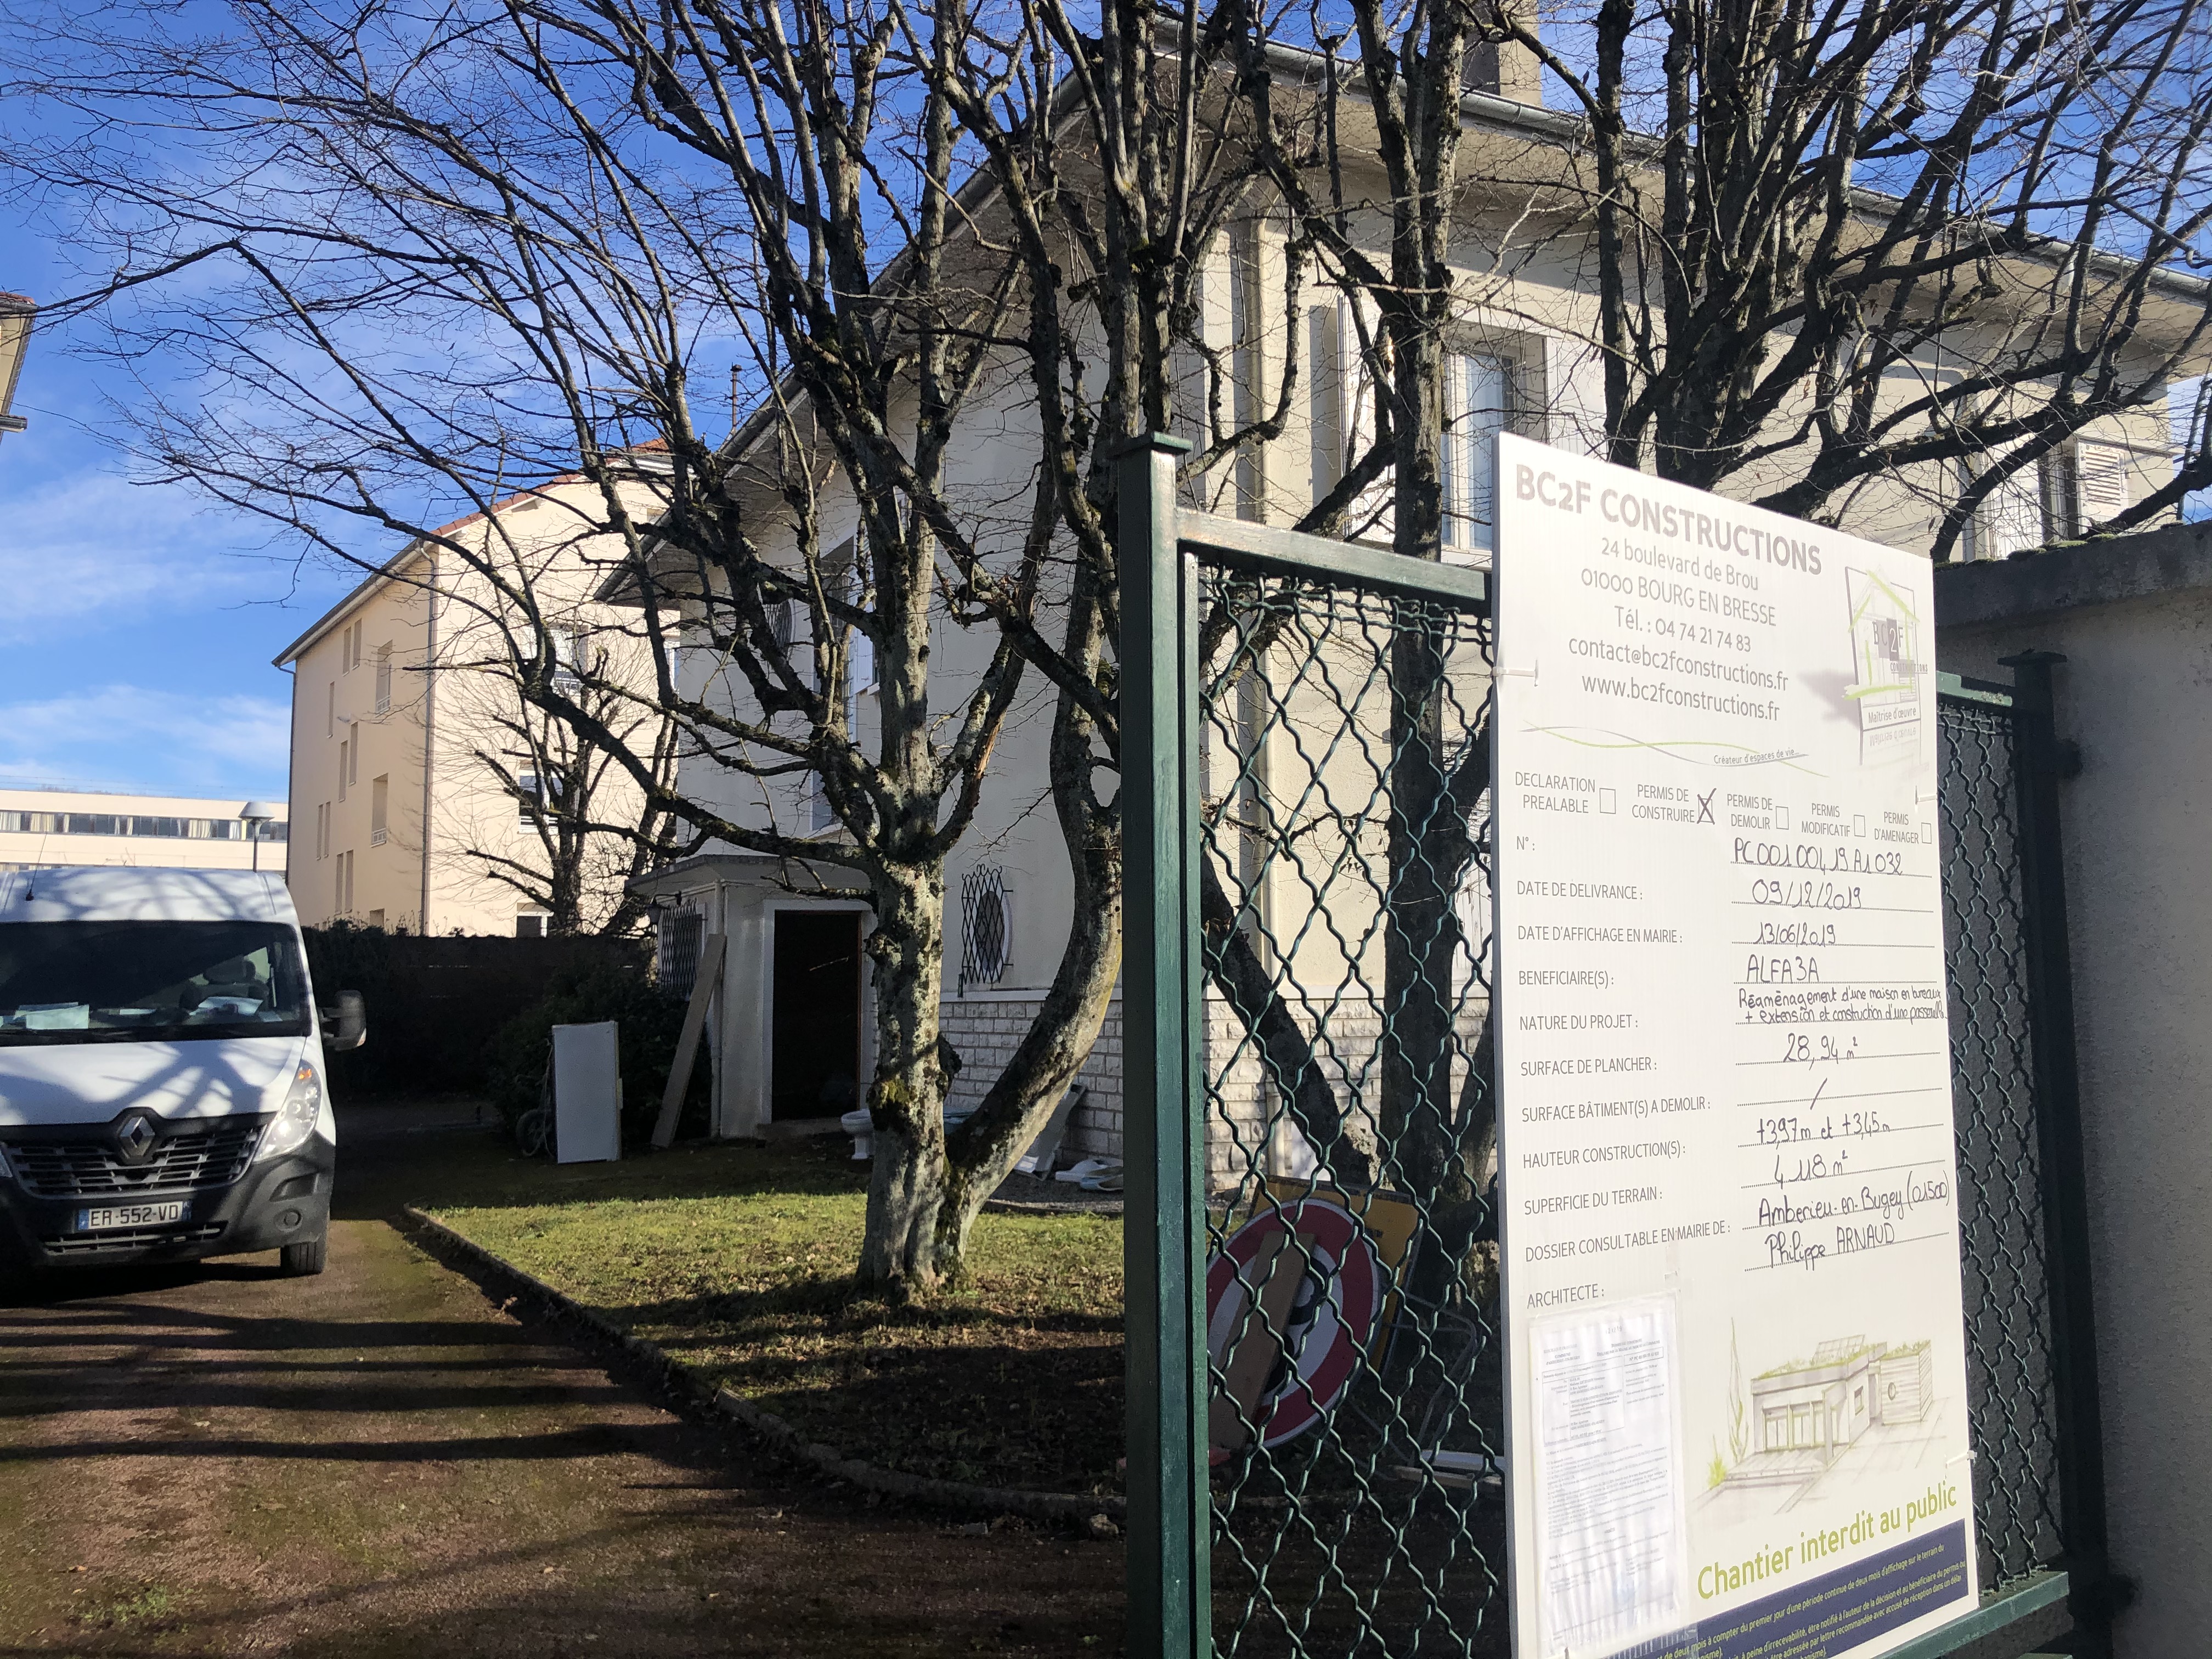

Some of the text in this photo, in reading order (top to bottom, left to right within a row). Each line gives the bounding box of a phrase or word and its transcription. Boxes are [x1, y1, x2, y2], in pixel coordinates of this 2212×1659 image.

[1516, 464, 1822, 575] BC2F CONSTRUCTIONS
[1602, 538, 1758, 591] 24 boulevard de Brou
[1581, 567, 1776, 627] 01000 BOURG EN BRESSE
[1615, 605, 1751, 652] Tél. 04 74 21 74 83
[1569, 638, 1788, 691] contact@bc2fconstructions.fr
[1890, 663, 1928, 672] CONSTRUCTIONS
[1582, 675, 1780, 721] www.bc2fconstructions.fr
[1869, 709, 1892, 724] Maîtrise
[1714, 754, 1742, 765] Créateur
[1745, 749, 1775, 764] d'espaces
[1776, 750, 1784, 759] de
[1515, 771, 1595, 793] DECLARATION
[1638, 784, 1689, 802] PERMIS DE
[1727, 793, 1773, 811] PERMIS DE
[1523, 794, 1589, 814] PREALABLE
[1632, 804, 1695, 823] CONSTRUIRE
[1812, 803, 1840, 817] PERMIS
[1731, 813, 1770, 830] DEMOLIR
[1883, 811, 1909, 825] PERMIS
[1802, 821, 1850, 837] MODIFICATIF
[1874, 828, 1918, 844] D'AMENAGER
[1516, 836, 1529, 850] N°
[1517, 880, 1637, 900] DATE DE DELIVRANCE
[1752, 878, 1861, 910] 09/12/2019
[1518, 926, 1677, 943] DATE D'AFFICHAGE EN MAIRIE
[1753, 922, 1836, 947] 13/06/2019
[1519, 970, 1609, 989] BENEFICIAIRE(S)
[1841, 986, 1866, 1002] d'une
[1870, 989, 1898, 1000] maison
[1901, 990, 1910, 1000] en
[1910, 985, 1941, 998] bureaux
[1520, 1014, 1632, 1031] NATURE DU PROJET
[1760, 1008, 1814, 1024] extension
[1820, 1004, 1830, 1022] et
[1783, 1032, 1839, 1071] 28,94
[1521, 1057, 1651, 1076] SURFACE DE PLANCHER
[1522, 1097, 1706, 1122] SURFACE BÂTIMENT(S) A DEMOLIR
[1821, 1116, 1833, 1139] et
[1523, 1140, 1680, 1169] HAUTEUR CONSTRUCTION(S)
[1525, 1186, 1657, 1215] SUPERFICIE DU TERRAIN
[1526, 1220, 1725, 1262] DOSSIER CONSULTABLE EN MAIRIE DE
[1837, 1222, 1895, 1254] ARNAUD
[1527, 1284, 1598, 1309] ARCHITECTE
[1697, 1544, 1793, 1599] Chantier
[1801, 1510, 1875, 1565] interdit
[1880, 1507, 1900, 1534] au
[1906, 1480, 1957, 1533] public
[1713, 1627, 1739, 1643] compter
[1740, 1622, 1748, 1633] du
[1749, 1614, 1772, 1632] premier
[1773, 1609, 1785, 1623] jour
[1824, 1585, 1847, 1599] continue
[1848, 1581, 1854, 1590] de
[1855, 1577, 1868, 1587] deux
[1869, 1571, 1881, 1582] mois
